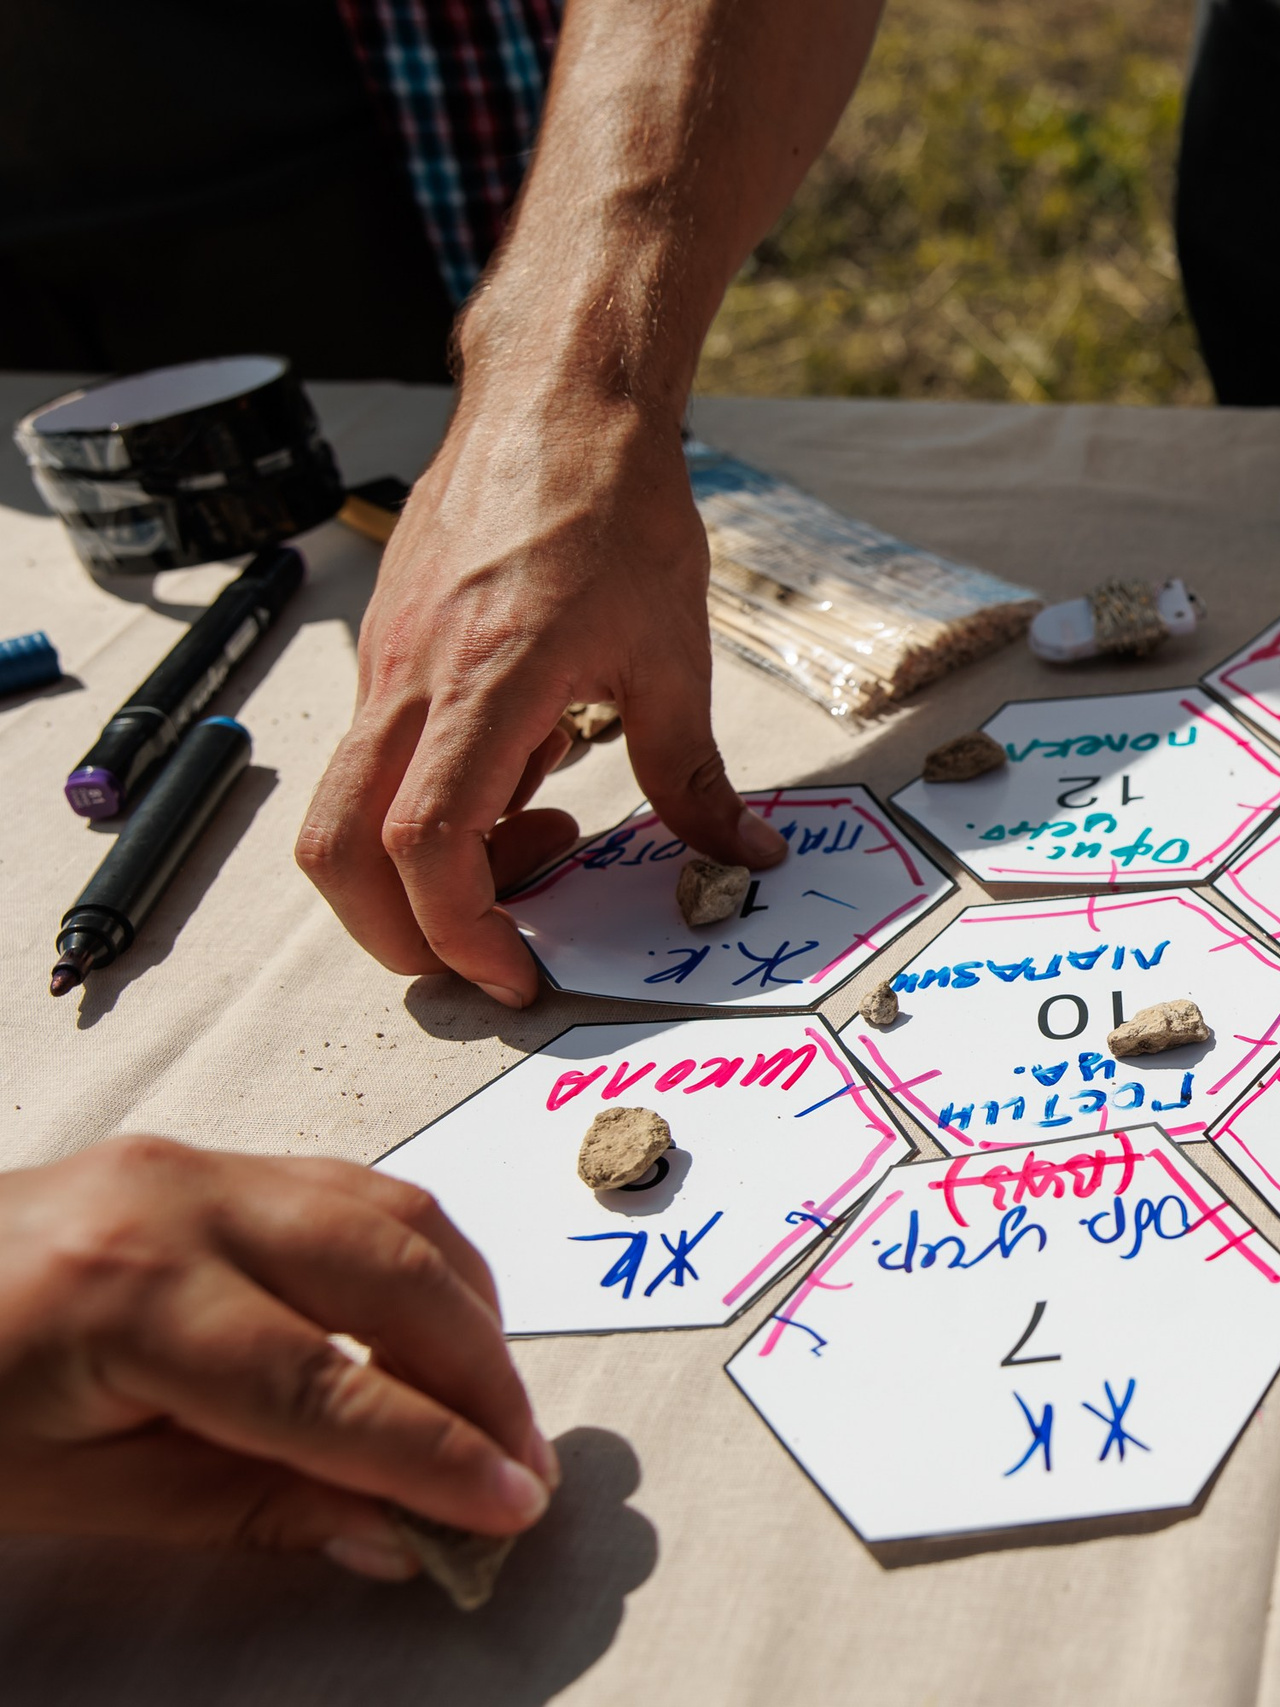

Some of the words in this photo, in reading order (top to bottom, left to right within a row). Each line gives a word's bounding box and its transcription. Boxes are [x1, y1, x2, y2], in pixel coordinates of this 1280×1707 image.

[1056, 775, 1145, 810] 12
[1037, 990, 1130, 1041] 10
[999, 1300, 1062, 1368] 7
[1002, 1377, 1151, 1478] ЖК
